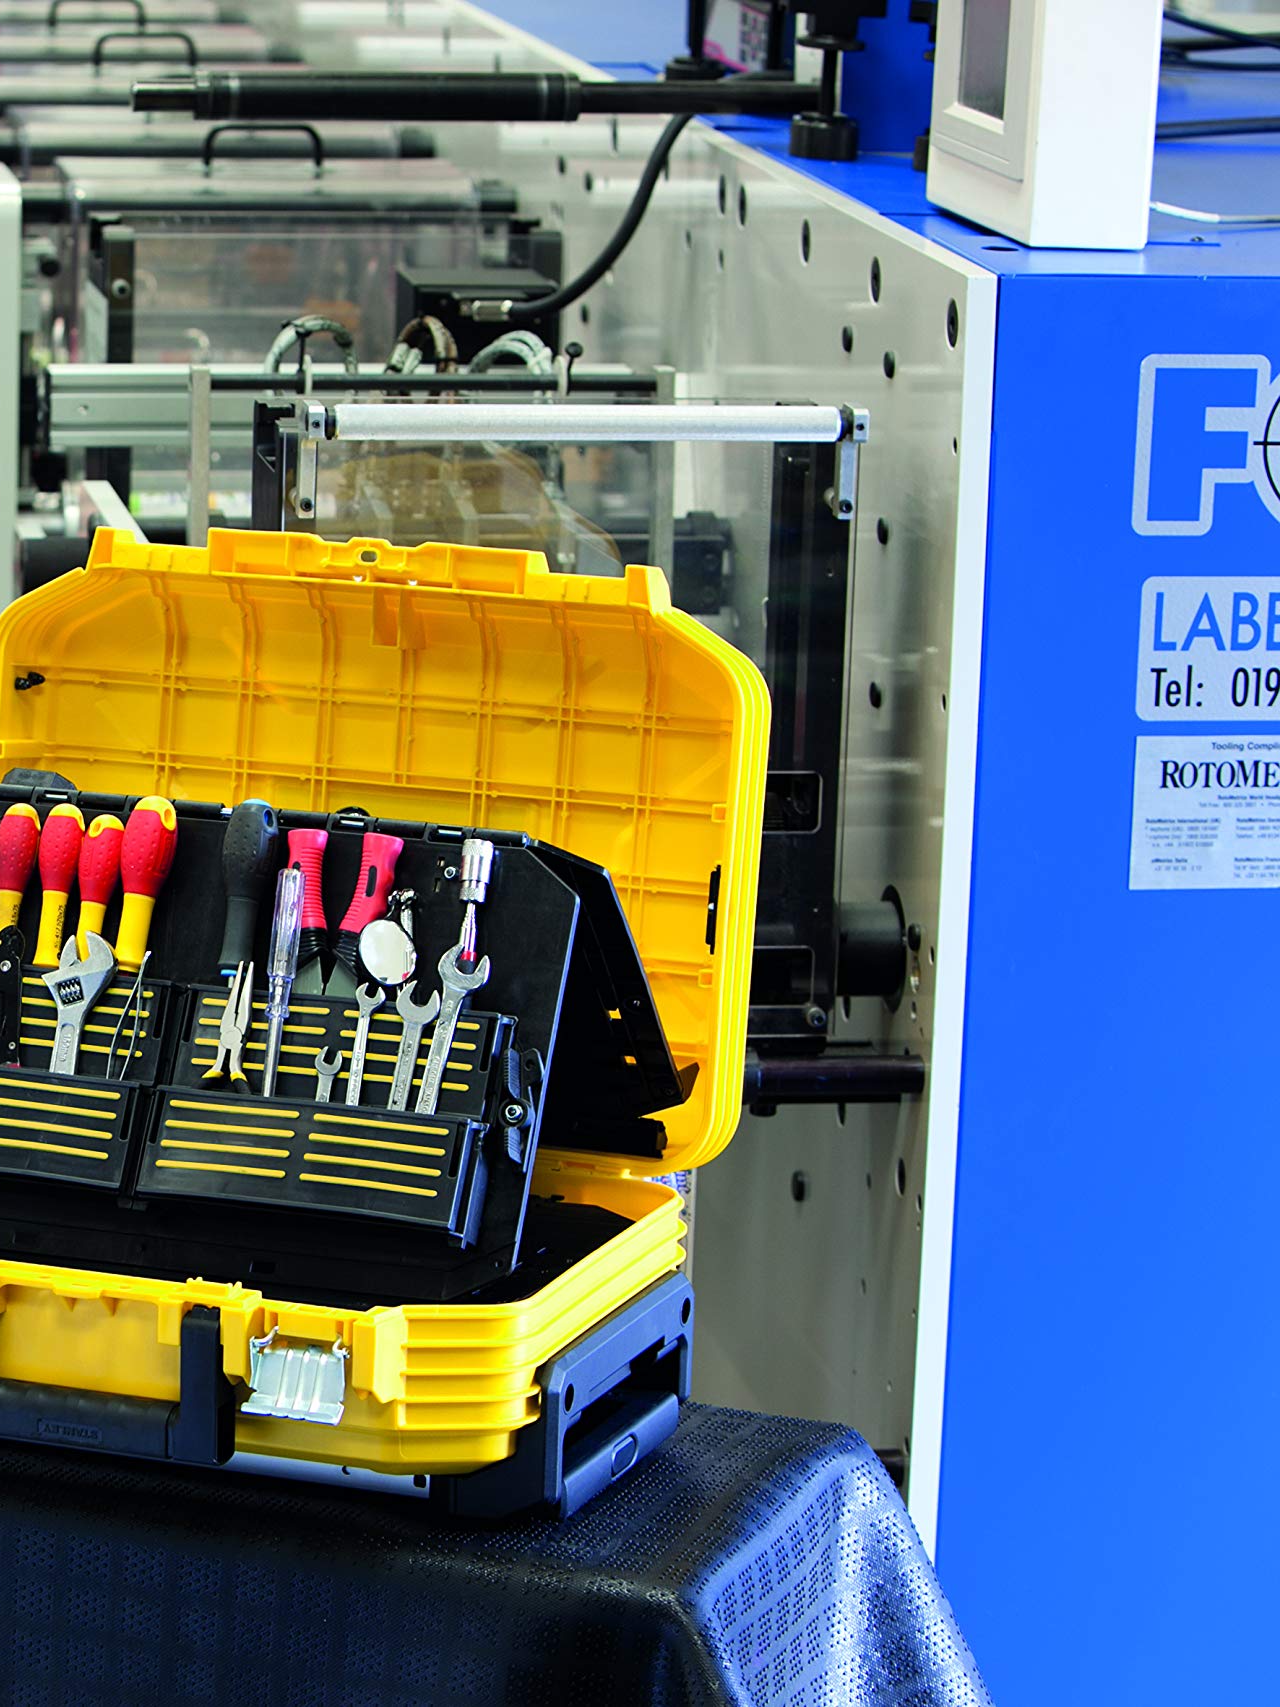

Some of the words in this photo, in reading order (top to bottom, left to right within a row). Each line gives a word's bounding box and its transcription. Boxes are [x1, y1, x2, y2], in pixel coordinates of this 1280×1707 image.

[1131, 354, 1280, 536] F
[1153, 591, 1280, 651] LABE
[1150, 664, 1204, 707] Tel:
[1231, 666, 1280, 707] 019
[1212, 741, 1245, 752] Tooling
